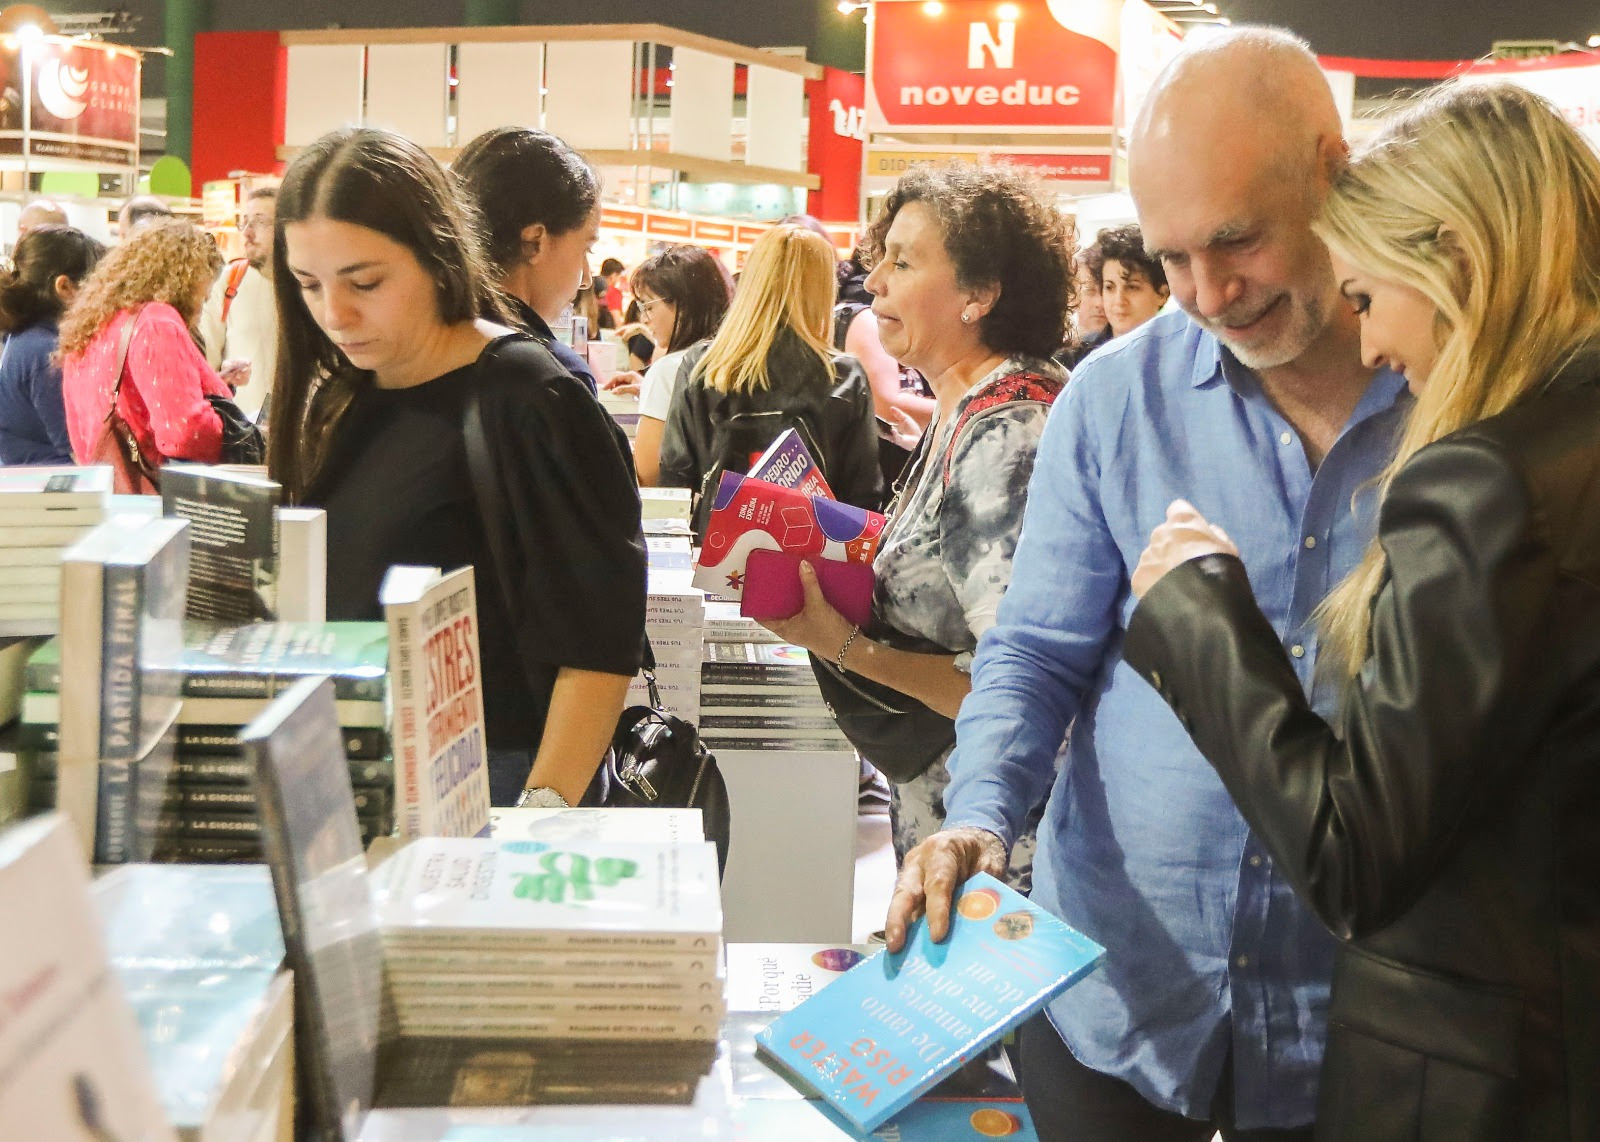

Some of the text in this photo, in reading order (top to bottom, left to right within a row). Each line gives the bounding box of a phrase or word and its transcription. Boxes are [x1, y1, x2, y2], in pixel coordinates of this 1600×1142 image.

[967, 22, 1016, 69] N
[900, 79, 1080, 106] noveduc
[778, 453, 808, 488] ORIDO
[108, 655, 133, 747] PARTIDA
[184, 736, 201, 744] LA
[191, 794, 207, 802] LA
[193, 821, 208, 829] LA
[791, 973, 812, 1005] adie
[994, 980, 1025, 1004] de
[899, 983, 973, 1040] amarte
[962, 994, 998, 1022] me
[861, 996, 947, 1063] De tanto
[789, 1030, 881, 1108] WALTER
[850, 1038, 914, 1086] RISO
